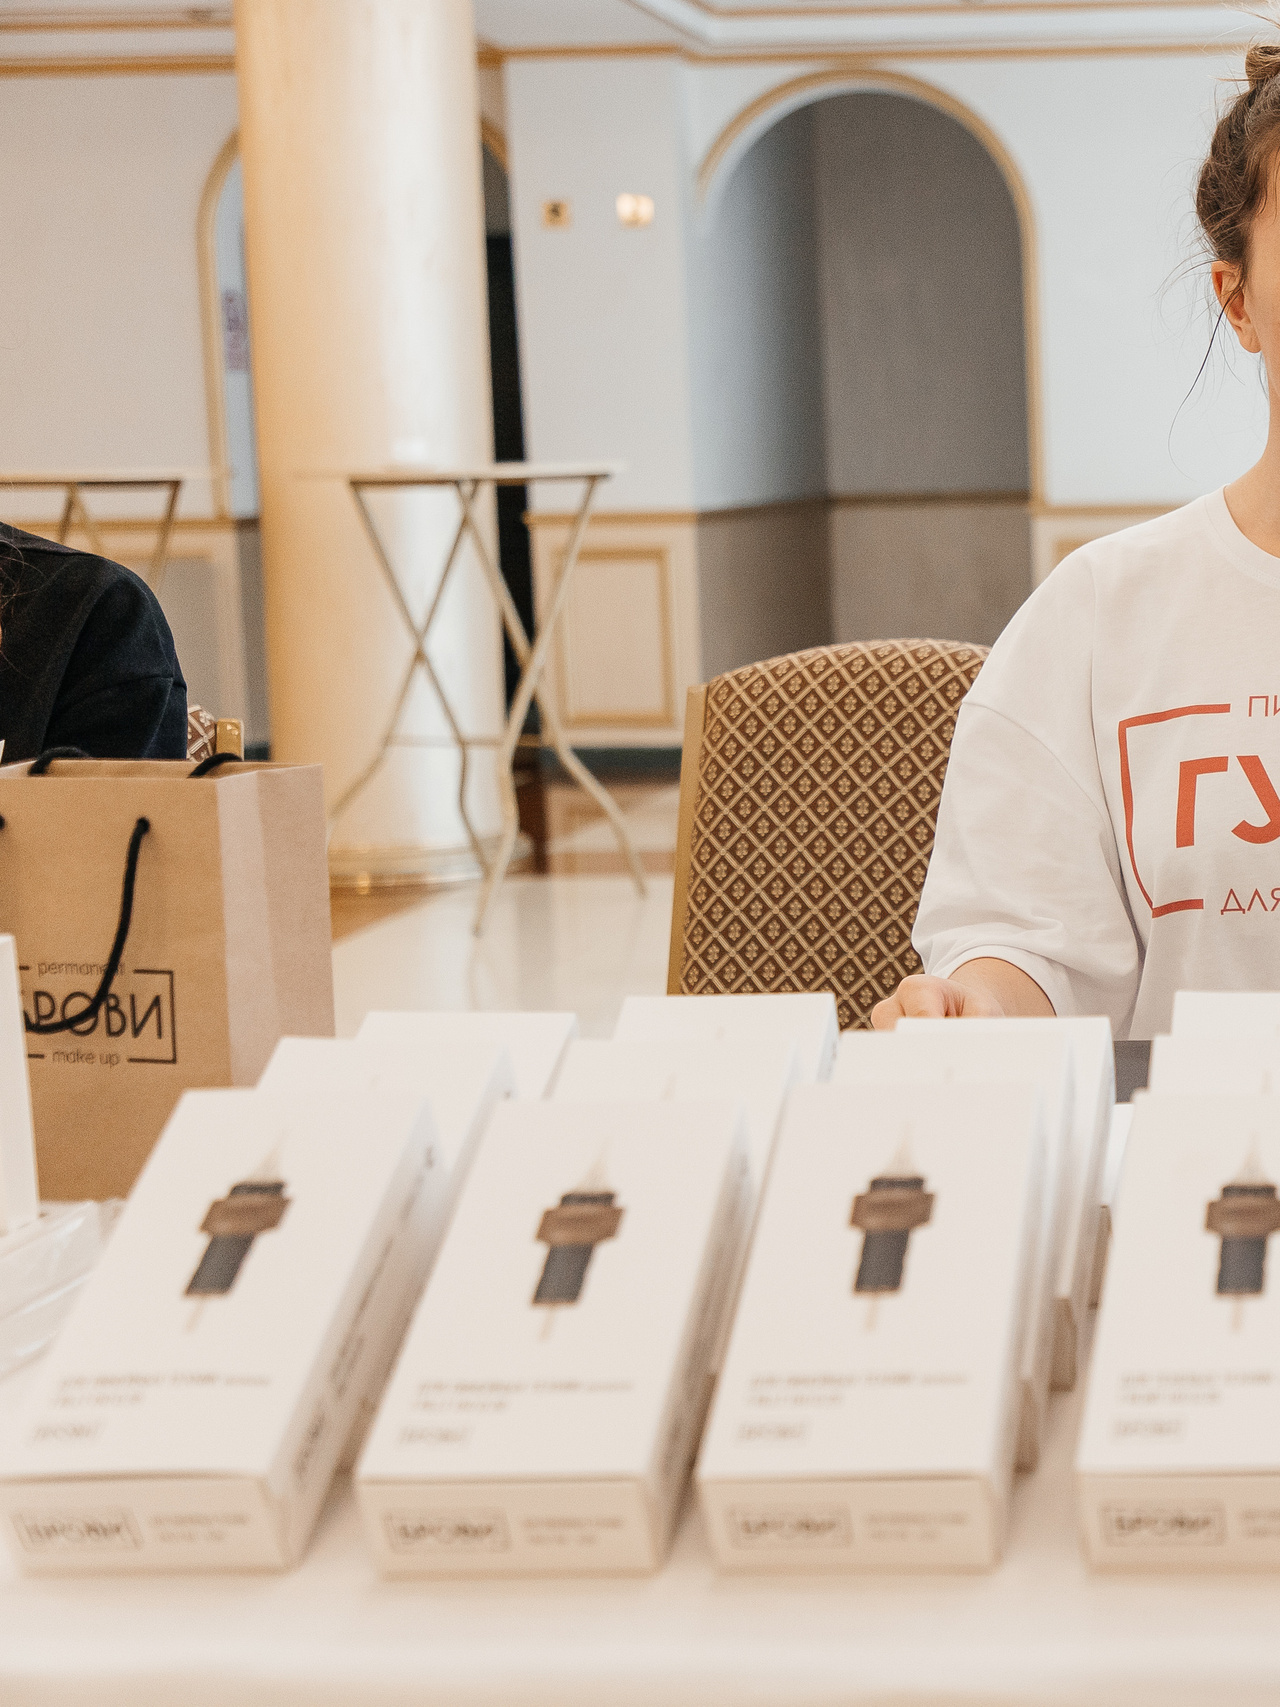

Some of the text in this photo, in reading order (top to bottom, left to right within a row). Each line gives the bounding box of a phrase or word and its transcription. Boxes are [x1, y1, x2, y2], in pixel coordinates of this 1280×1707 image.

[21, 989, 163, 1040] РОВИ
[51, 1049, 121, 1069] make up
